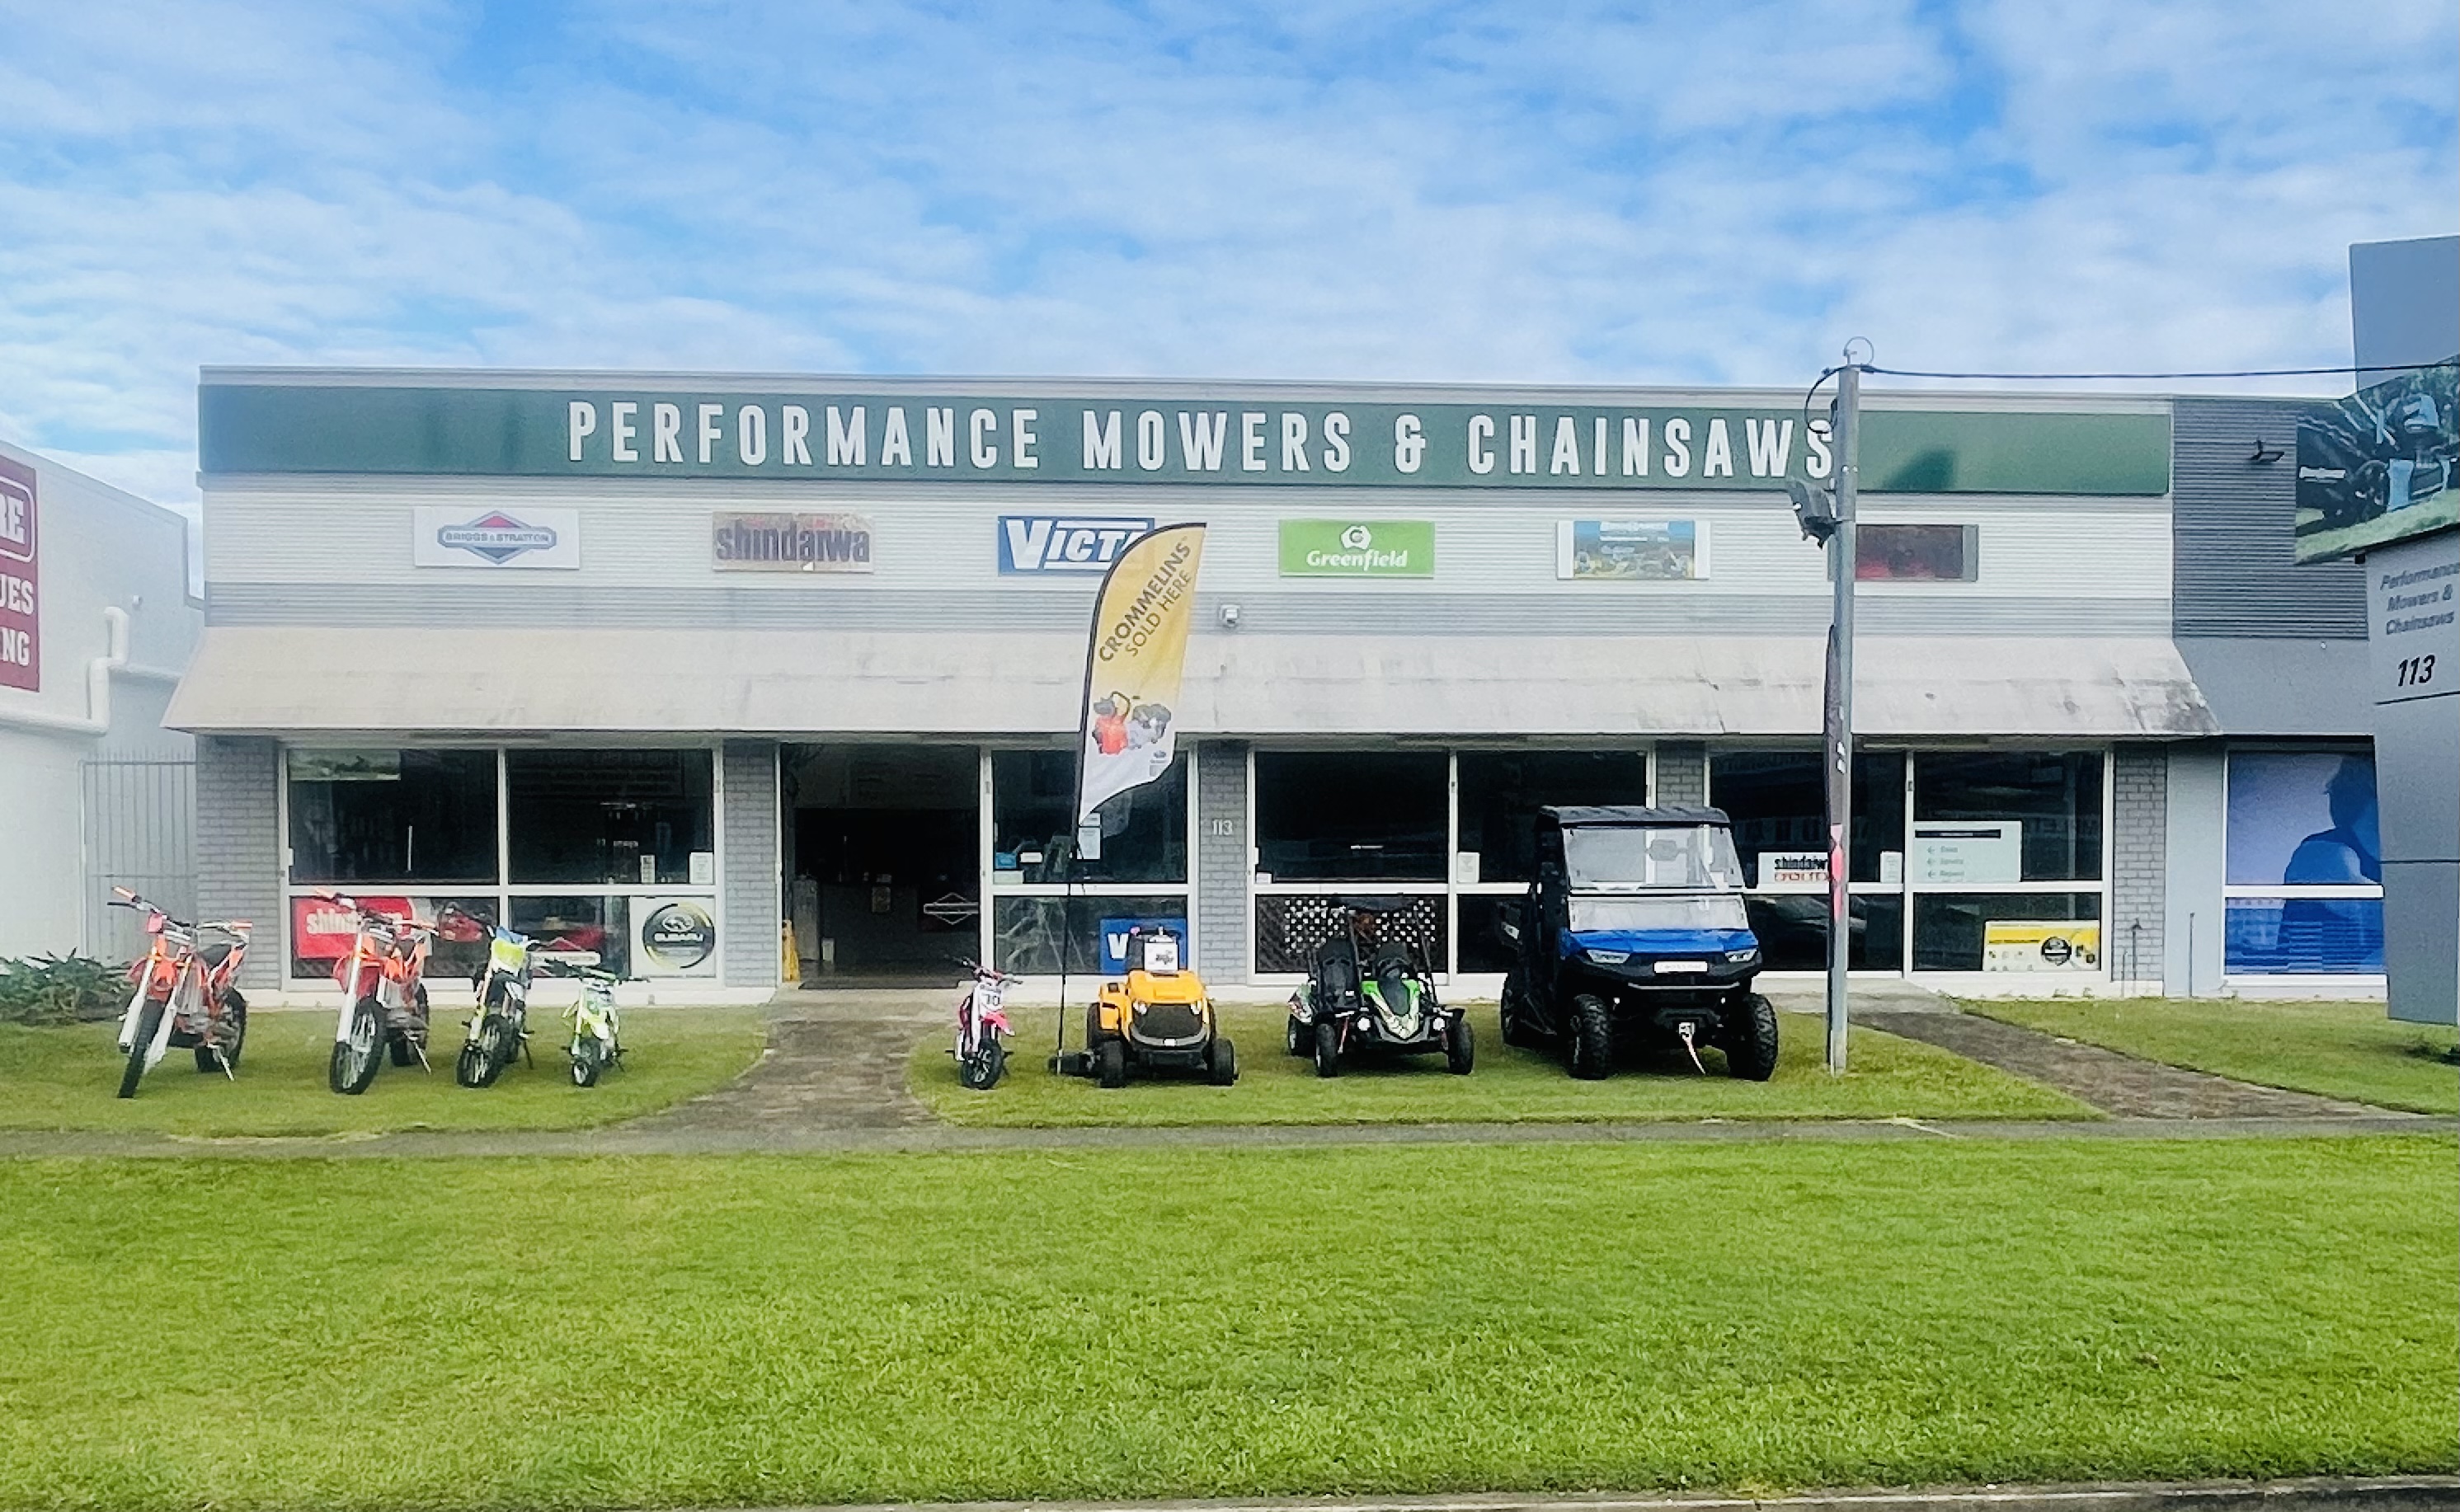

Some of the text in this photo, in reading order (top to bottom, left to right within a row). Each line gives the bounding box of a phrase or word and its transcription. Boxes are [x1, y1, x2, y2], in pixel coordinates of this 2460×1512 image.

[567, 401, 1834, 480] PERFORMANCE MOWERS & CHAINSAWS
[716, 519, 871, 563] shindaiwa
[1305, 548, 1409, 571] Greenfield
[1099, 542, 1191, 662] CROMMELINS
[1125, 570, 1192, 657] SOLD HERE
[2397, 654, 2435, 687] 113
[1213, 819, 1233, 835] 113
